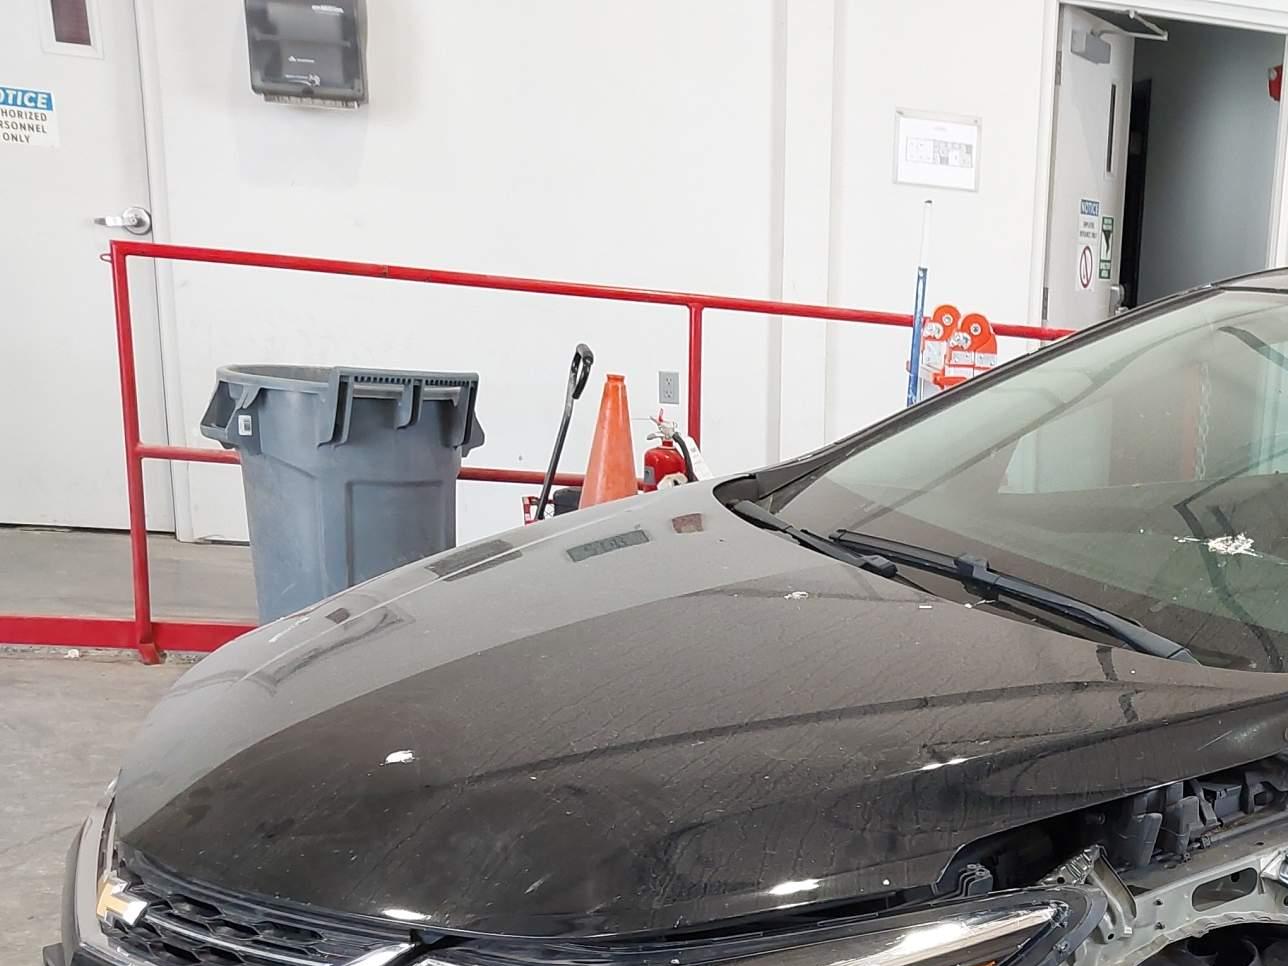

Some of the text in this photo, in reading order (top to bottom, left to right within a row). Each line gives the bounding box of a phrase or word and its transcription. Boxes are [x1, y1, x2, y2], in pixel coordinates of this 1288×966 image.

[1, 109, 47, 122] HORIZED
[2, 132, 30, 143] ONLY
[1081, 202, 1098, 215] NOTICE
